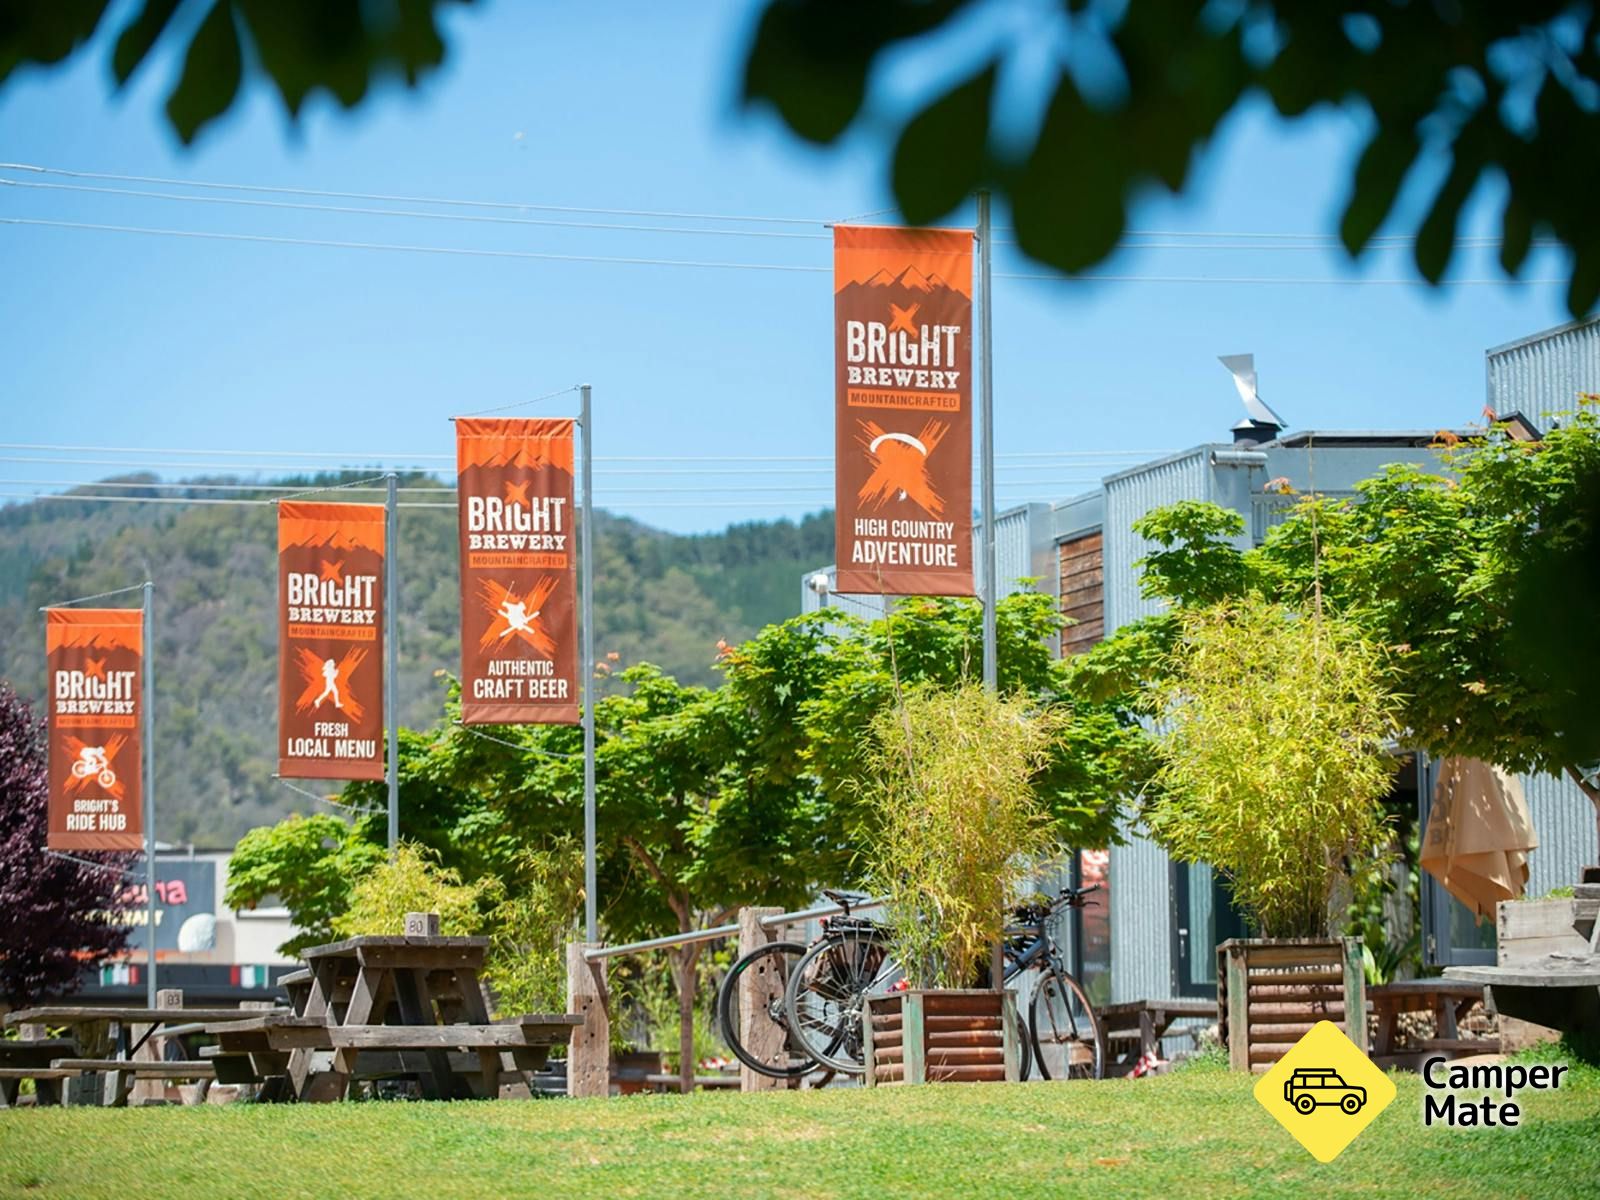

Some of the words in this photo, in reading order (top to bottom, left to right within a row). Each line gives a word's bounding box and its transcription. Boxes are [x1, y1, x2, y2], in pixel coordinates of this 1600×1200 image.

[847, 366, 960, 389] BREWERY
[850, 392, 957, 409] MOUNTAINCRAFTED
[854, 518, 888, 538] HIGH
[891, 520, 954, 540] COUNTRY
[468, 534, 567, 550] BREWERY
[472, 554, 565, 567] MOUNTAINCRAFTED
[851, 540, 958, 567] ADVENTURE
[288, 607, 376, 624] BREWERY
[488, 660, 554, 676] AUTHENTIC
[473, 678, 524, 699] CRAFT
[528, 678, 568, 699] BEER
[56, 700, 135, 714] BREWERY
[314, 722, 349, 738] FRESH
[287, 737, 331, 757] LOCAL
[334, 739, 376, 758] MENU
[74, 799, 119, 813] BRIGHT'S
[66, 814, 96, 831] RIDE
[99, 814, 127, 831] HUB
[409, 920, 423, 933] 80
